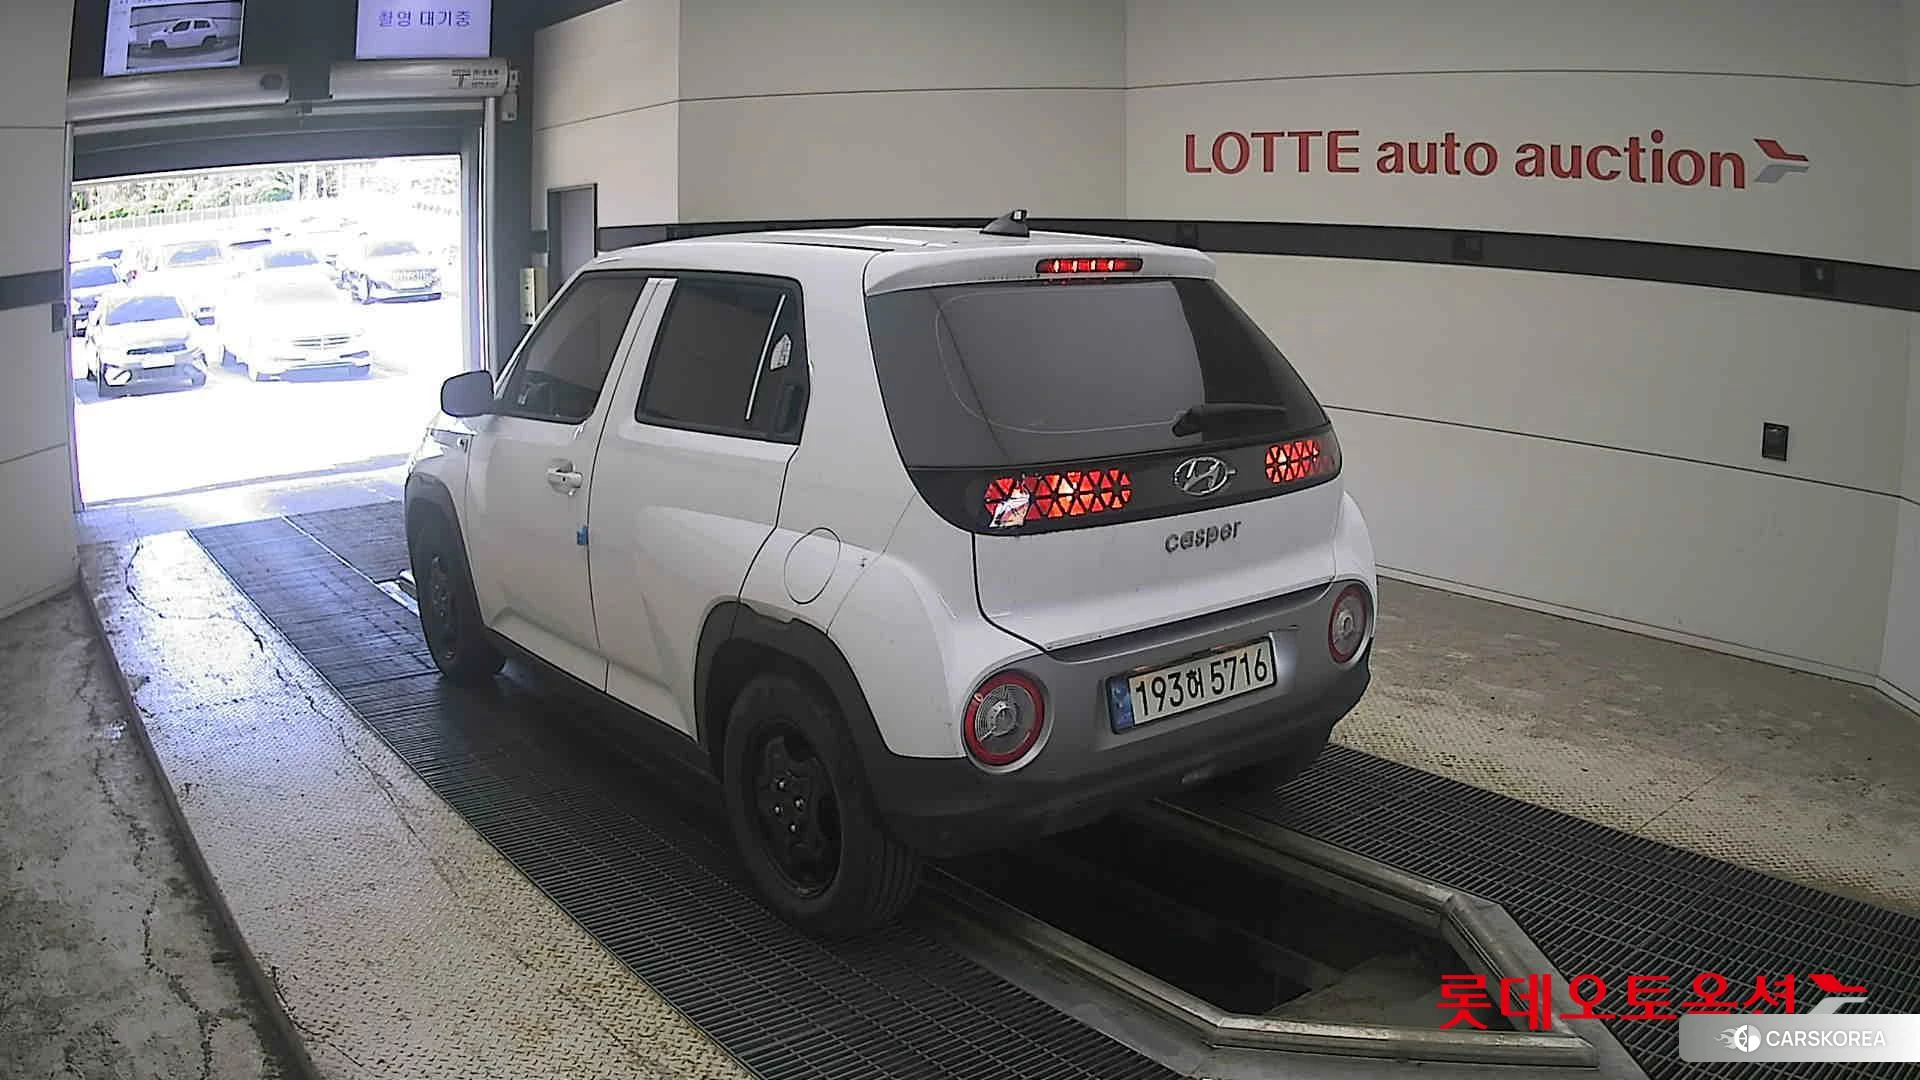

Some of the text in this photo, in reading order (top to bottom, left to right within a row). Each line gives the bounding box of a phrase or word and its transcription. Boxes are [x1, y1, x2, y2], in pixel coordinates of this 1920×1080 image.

[420, 10, 472, 27] 대기중
[1185, 129, 1747, 189] LOTTE auto auction
[1165, 521, 1242, 553] casper
